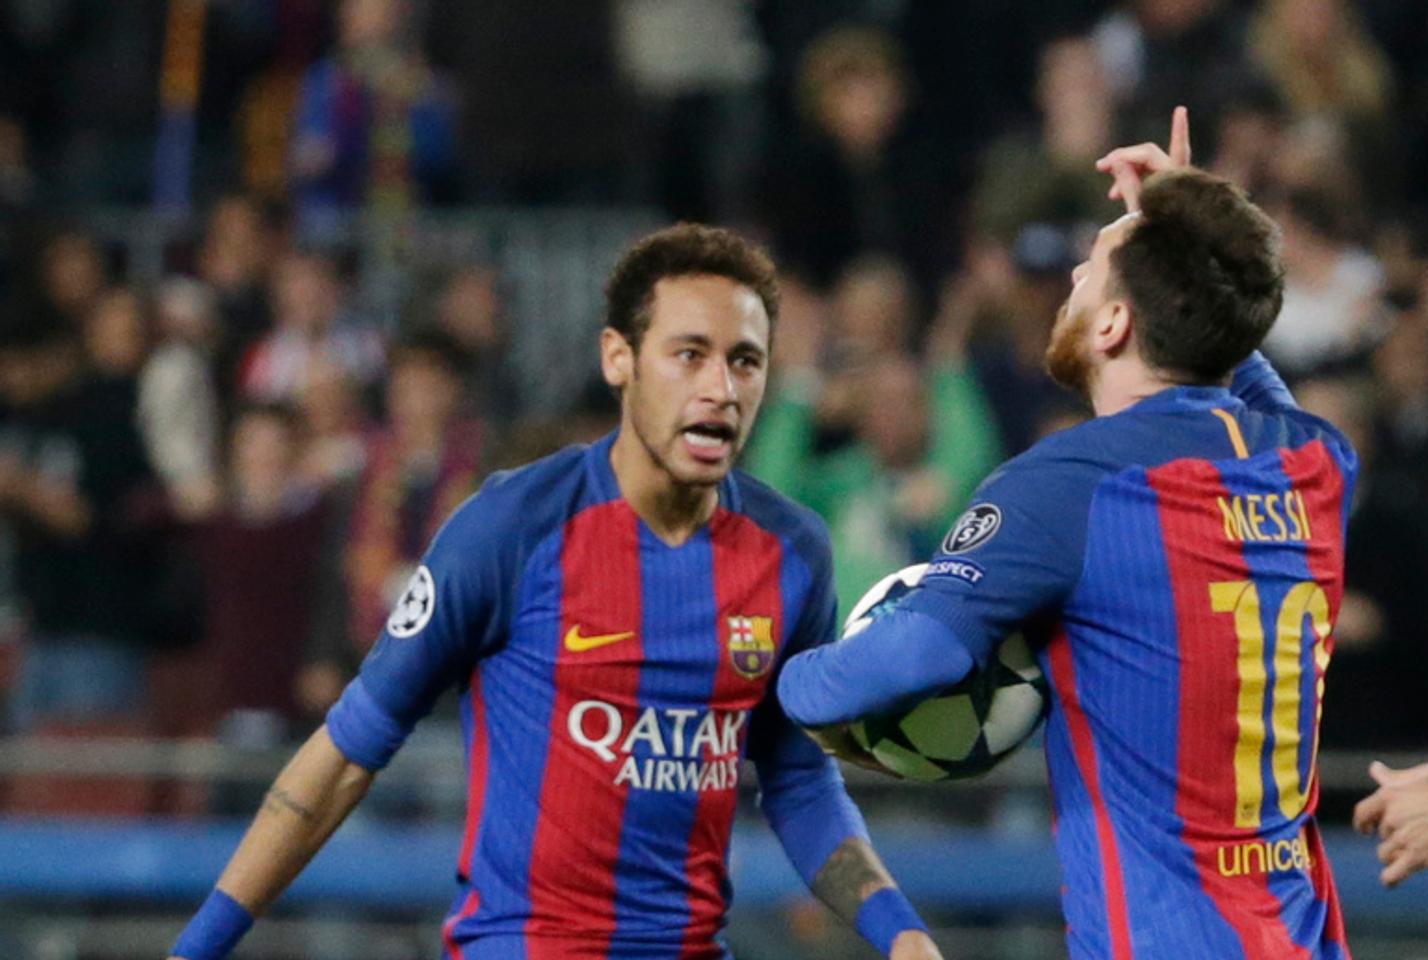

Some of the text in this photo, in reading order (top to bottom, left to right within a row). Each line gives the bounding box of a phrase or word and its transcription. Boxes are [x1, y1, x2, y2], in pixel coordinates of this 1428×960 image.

[1216, 488, 1312, 542] MESSI
[567, 699, 747, 763] QATAR
[1208, 580, 1332, 828] 10
[1217, 838, 1316, 877] unice
